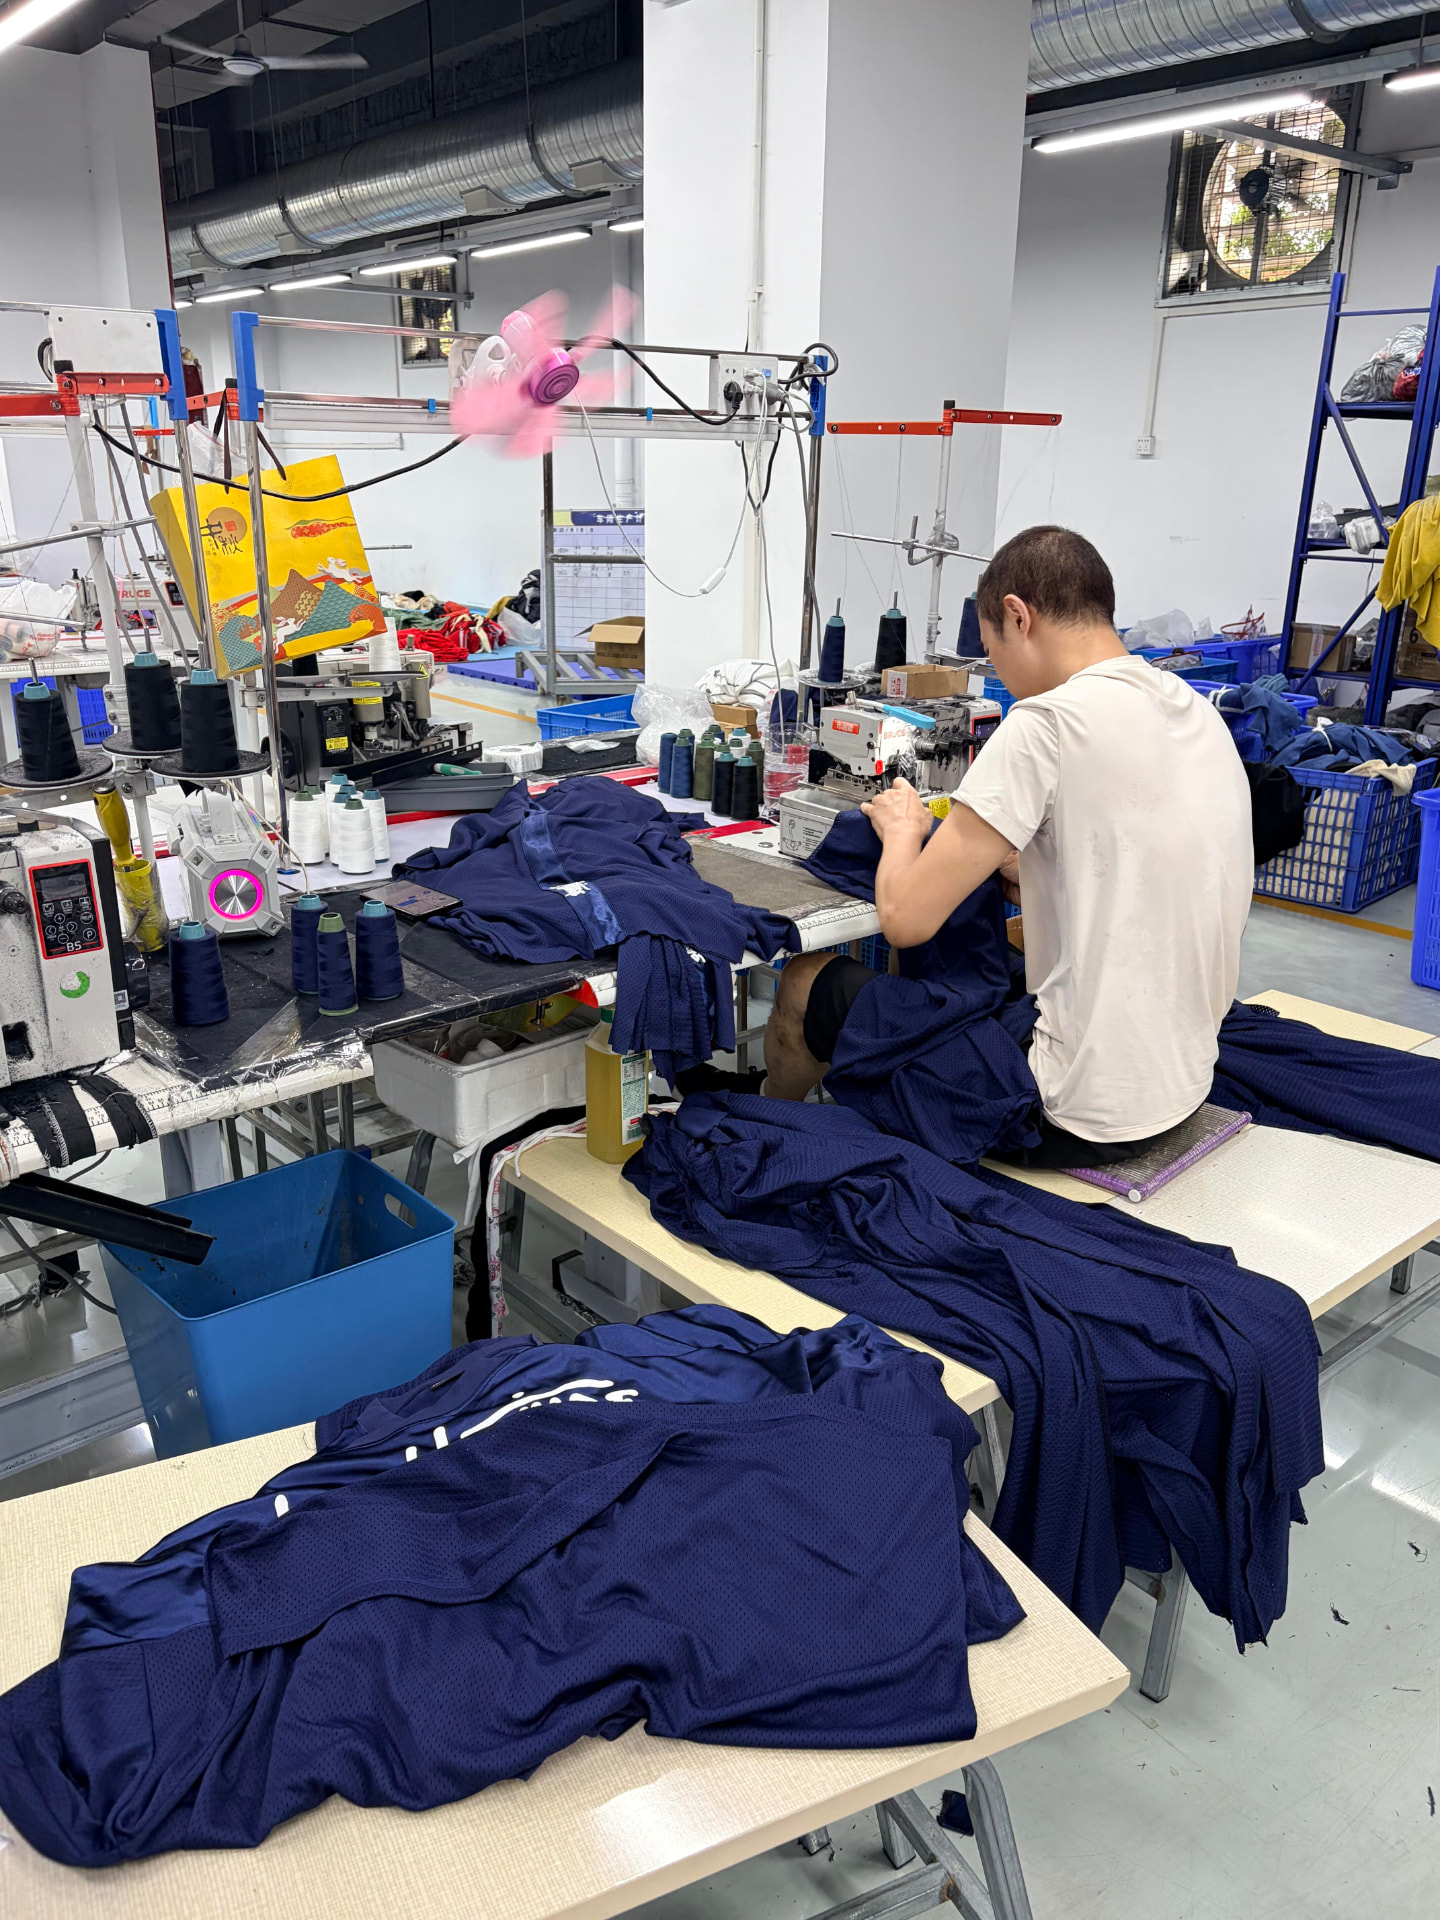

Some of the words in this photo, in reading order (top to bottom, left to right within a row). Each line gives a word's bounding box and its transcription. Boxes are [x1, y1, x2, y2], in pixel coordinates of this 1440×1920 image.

[116, 589, 151, 599] RUCE
[1409, 627, 1419, 644] 6
[883, 729, 906, 740] BRUCE
[66, 940, 82, 952] B5
